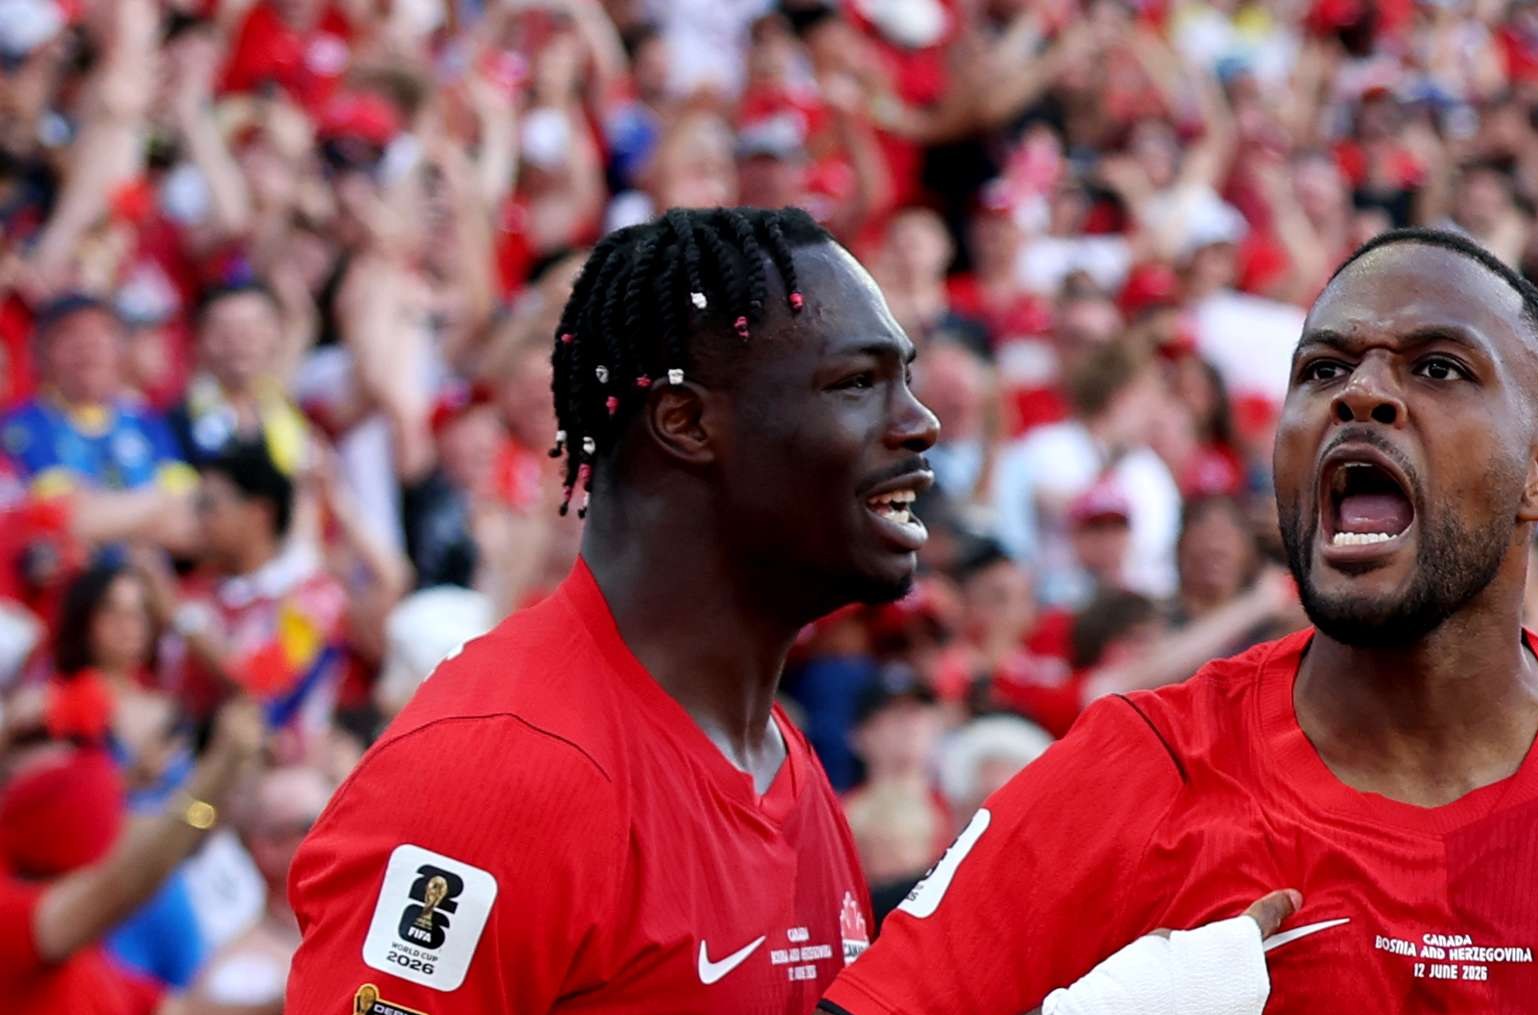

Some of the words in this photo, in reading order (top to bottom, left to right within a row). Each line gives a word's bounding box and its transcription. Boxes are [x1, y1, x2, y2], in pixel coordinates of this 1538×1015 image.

[407, 926, 432, 943] FIFA
[1422, 933, 1472, 946] CANADA
[391, 941, 420, 957] WORLD
[420, 951, 439, 962] CUP
[1375, 935, 1417, 957] BOSNIA
[1420, 946, 1446, 960] AND
[1449, 947, 1533, 962] HERZEGOVINA
[386, 950, 435, 976] 2026
[1413, 962, 1425, 978] 12
[1429, 963, 1458, 979] JUNE
[1462, 965, 1488, 980] 2026
